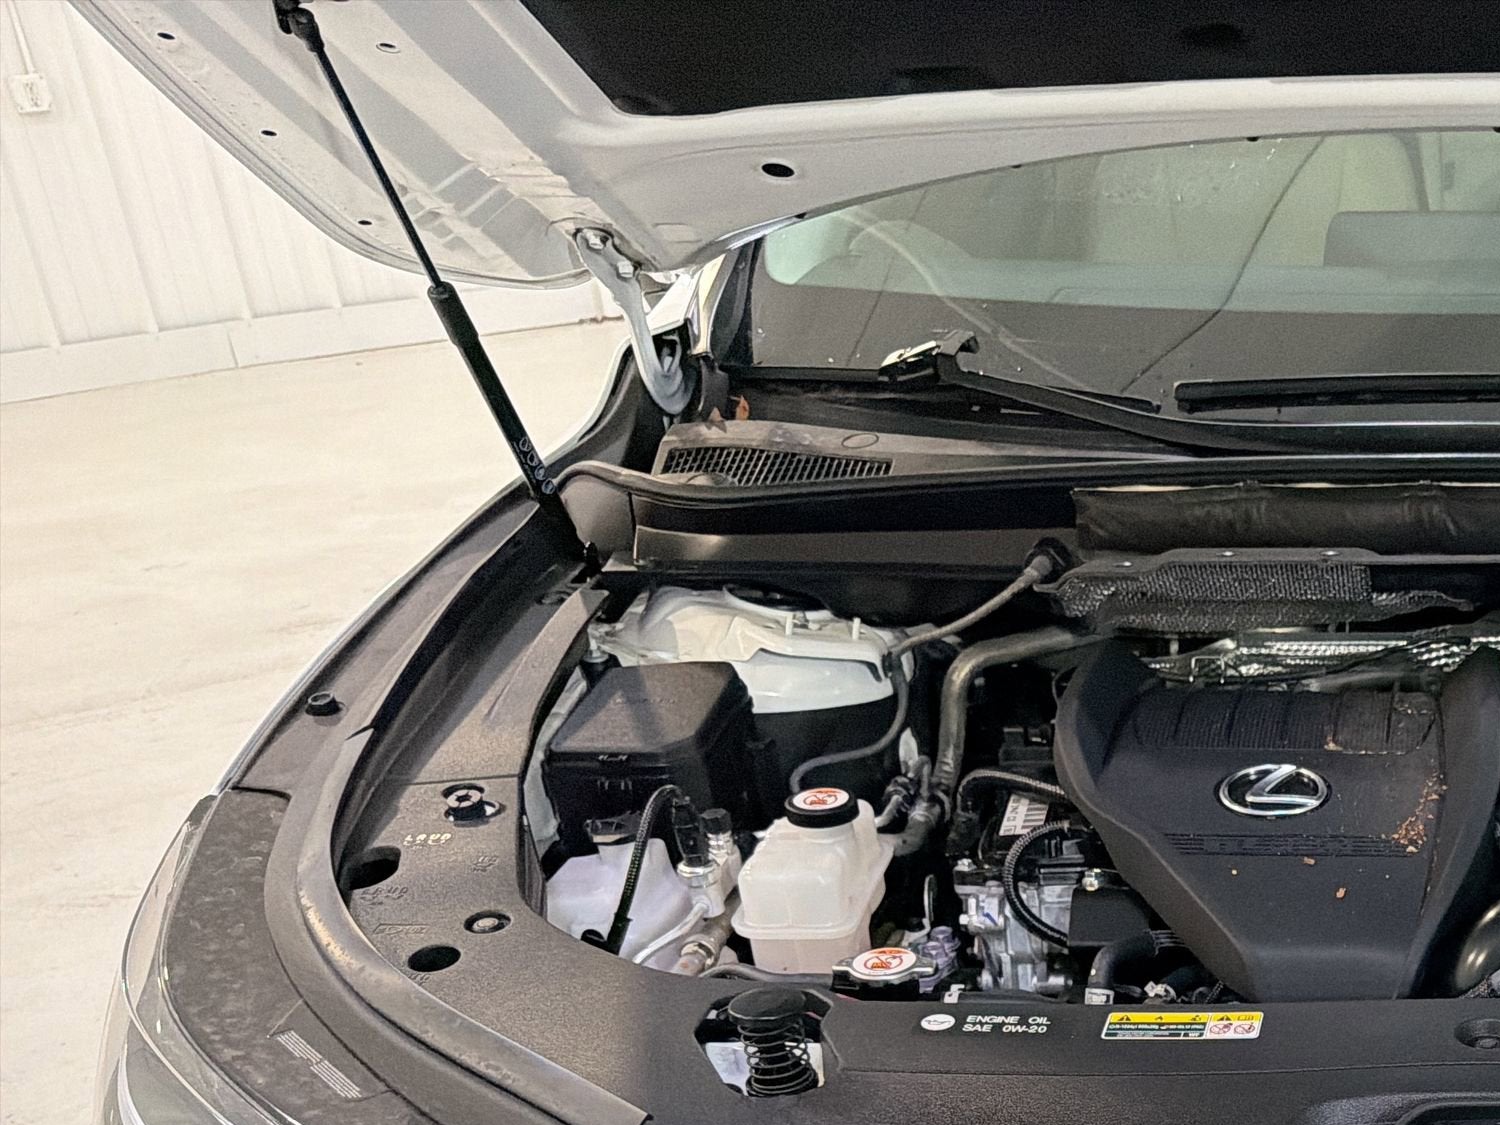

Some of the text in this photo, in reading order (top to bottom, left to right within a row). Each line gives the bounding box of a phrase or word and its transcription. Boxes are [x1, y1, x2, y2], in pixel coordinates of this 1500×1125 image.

[966, 1014, 1052, 1025] ENGINE OIL
[961, 1023, 1048, 1034] SAE 0W-20
